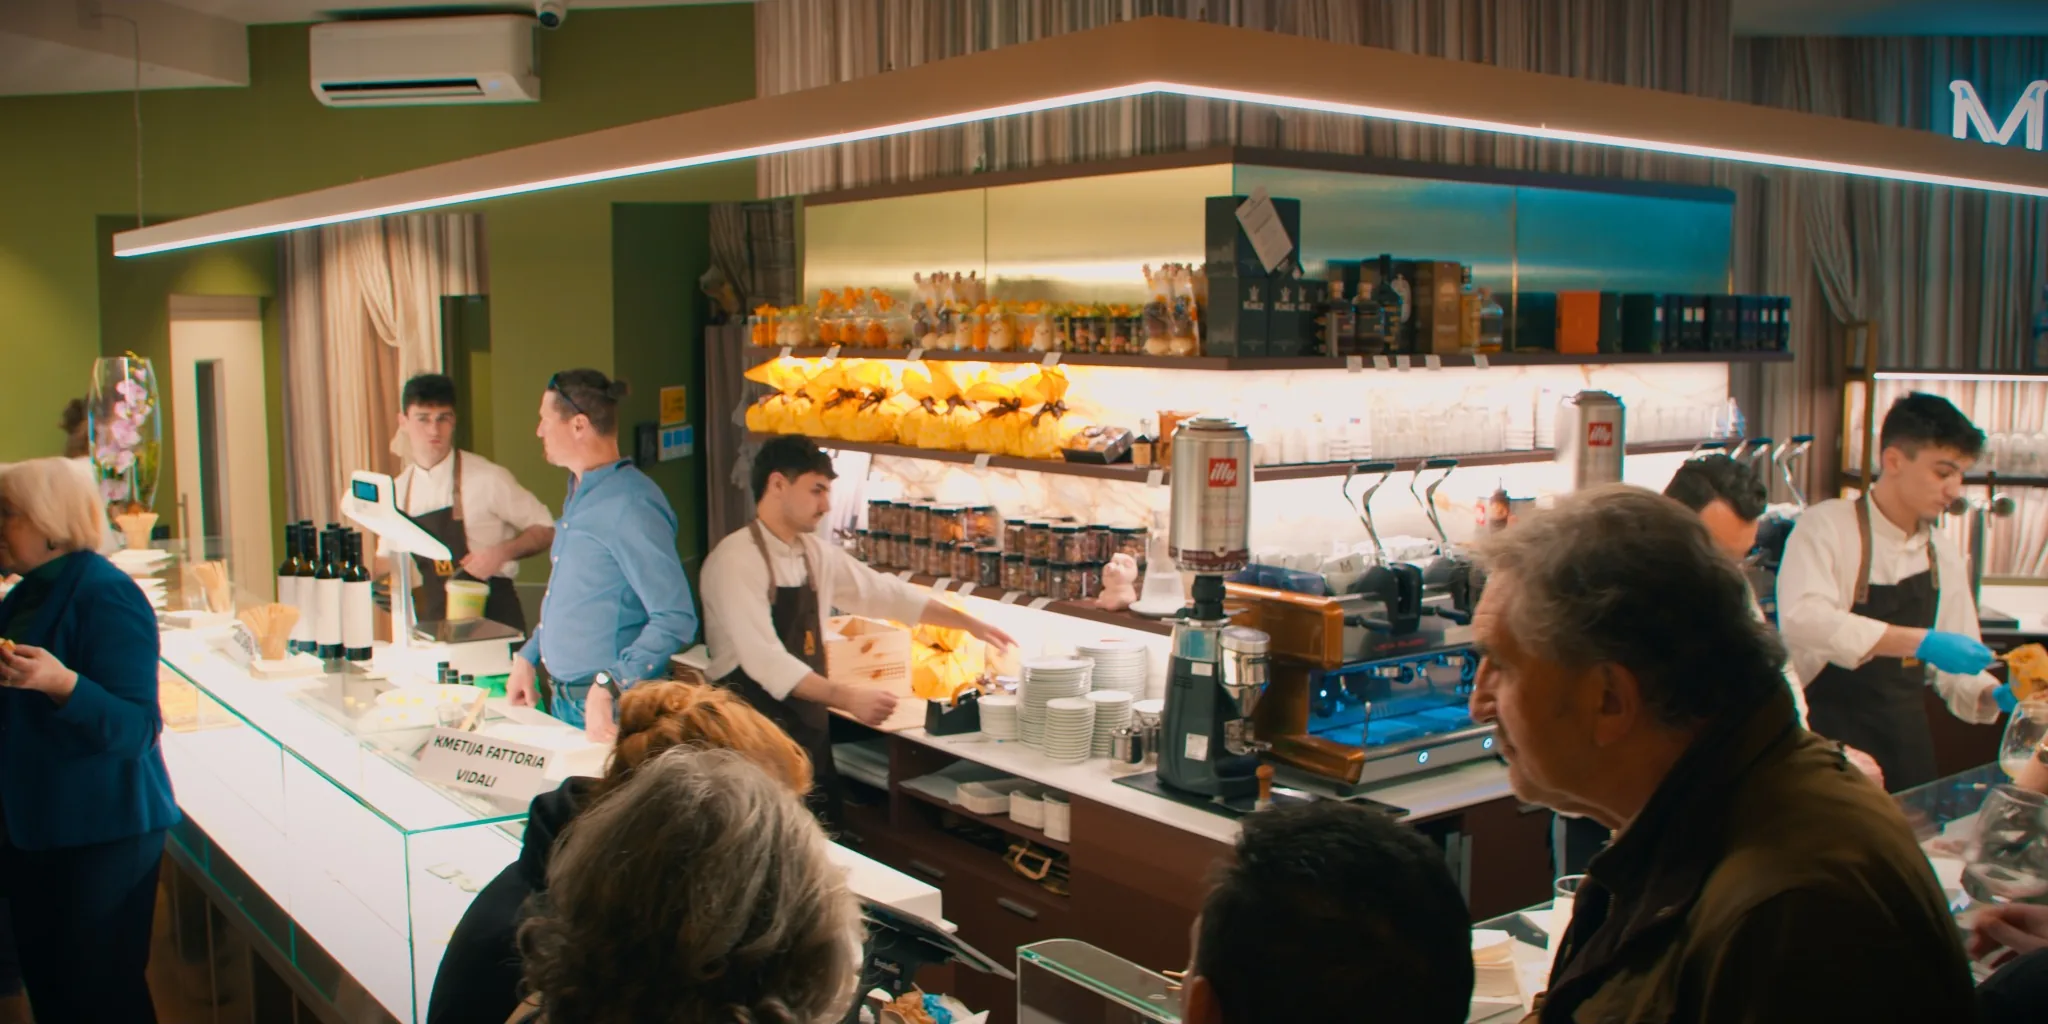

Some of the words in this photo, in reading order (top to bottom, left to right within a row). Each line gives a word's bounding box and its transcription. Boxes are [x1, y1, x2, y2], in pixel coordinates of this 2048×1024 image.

[1211, 462, 1236, 484] illy
[434, 736, 482, 756] KMETIJA
[486, 746, 545, 768] FATTORIA
[456, 769, 497, 787] VIDALI
